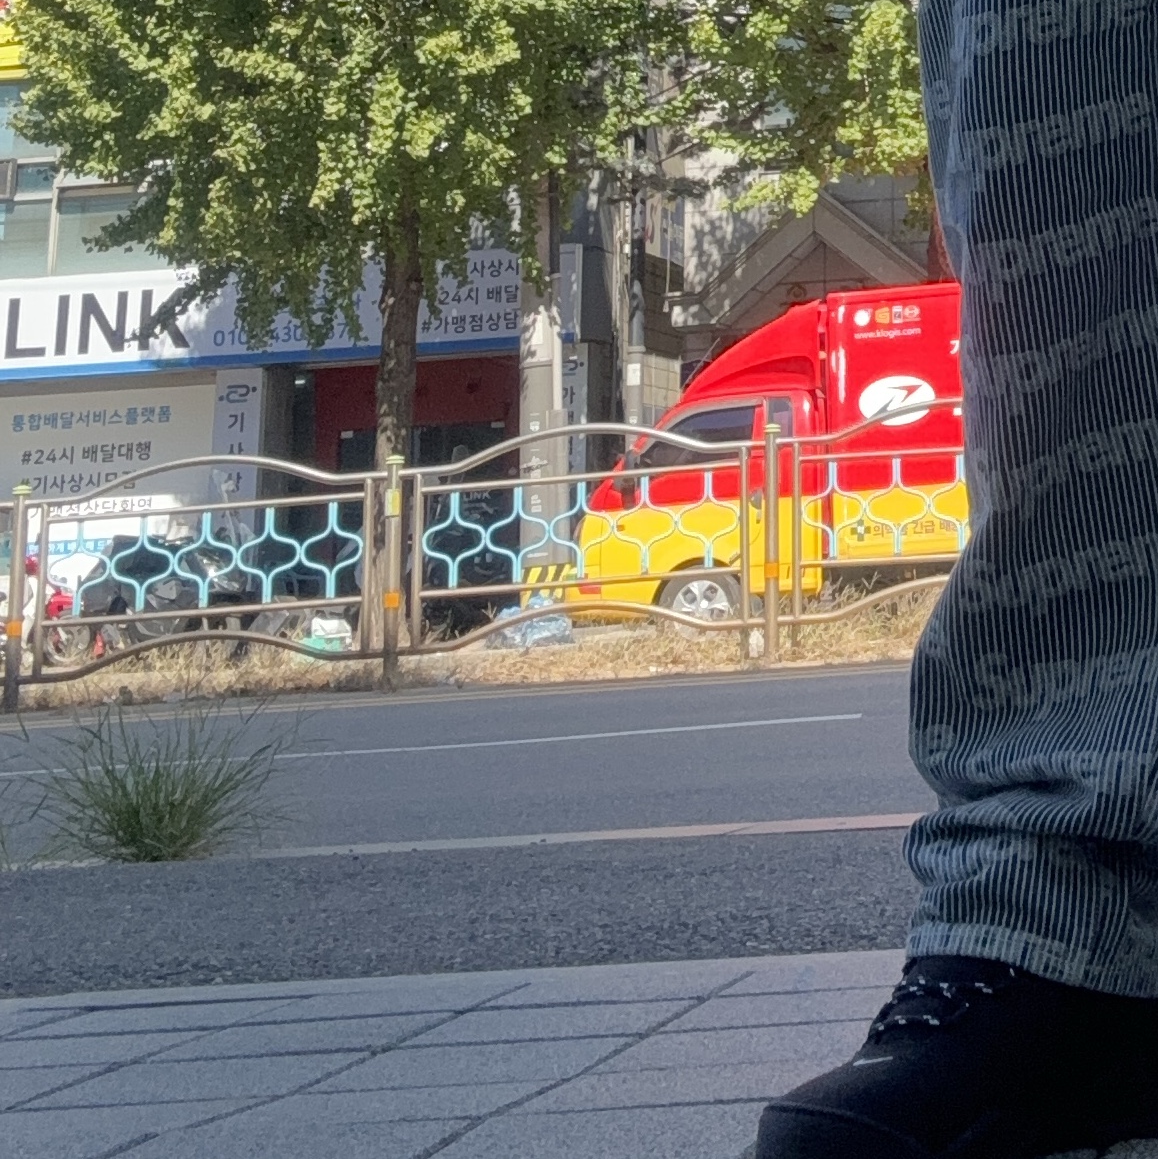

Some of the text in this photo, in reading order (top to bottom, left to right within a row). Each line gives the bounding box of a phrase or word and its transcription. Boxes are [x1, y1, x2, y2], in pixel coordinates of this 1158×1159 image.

[4, 289, 191, 359] LINK
[12, 405, 172, 433] 통합배달서비스플랫폼
[21, 441, 152, 466] #24시 배달대행
